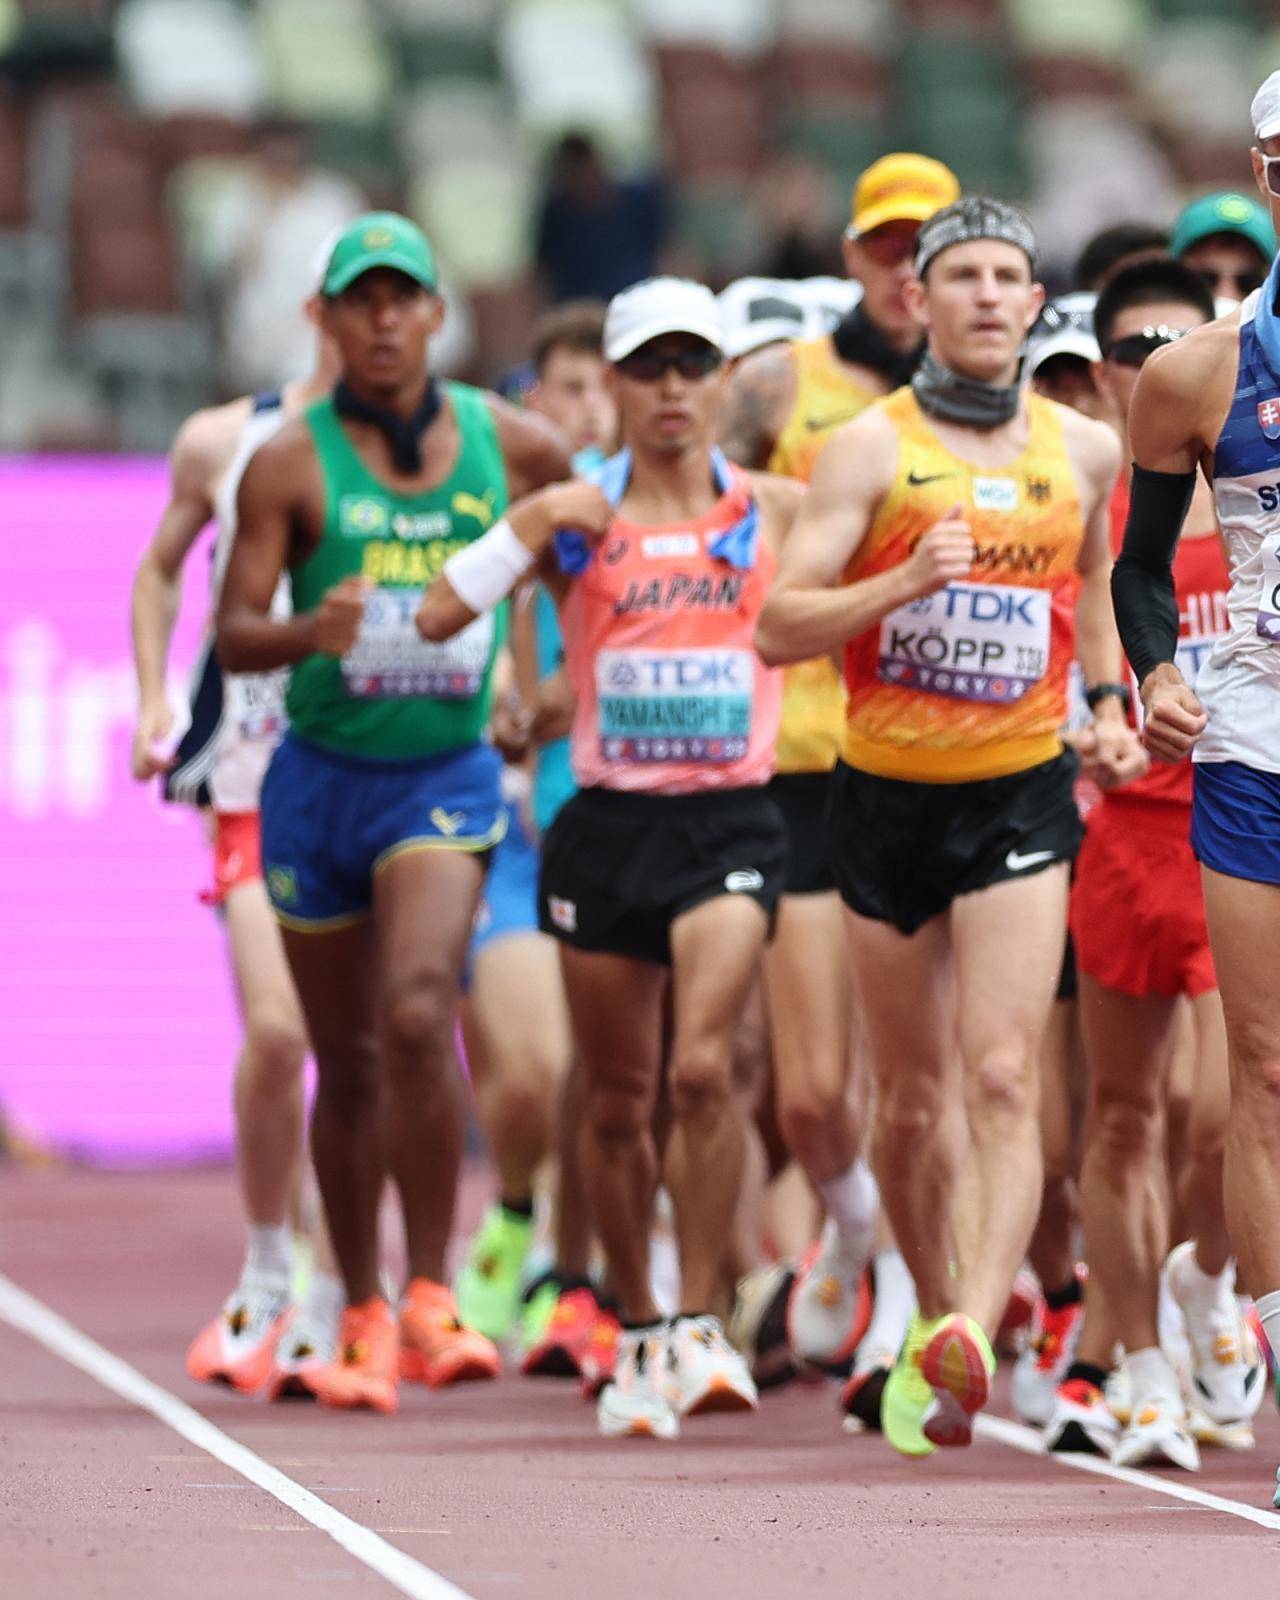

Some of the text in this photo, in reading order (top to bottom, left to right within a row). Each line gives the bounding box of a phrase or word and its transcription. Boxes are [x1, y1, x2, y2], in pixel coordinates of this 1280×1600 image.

[910, 533, 1058, 573] MANY
[613, 573, 741, 616] JAPAN
[943, 588, 1035, 626] TDK
[890, 627, 1006, 668] KÖPP
[645, 656, 737, 686] TDK
